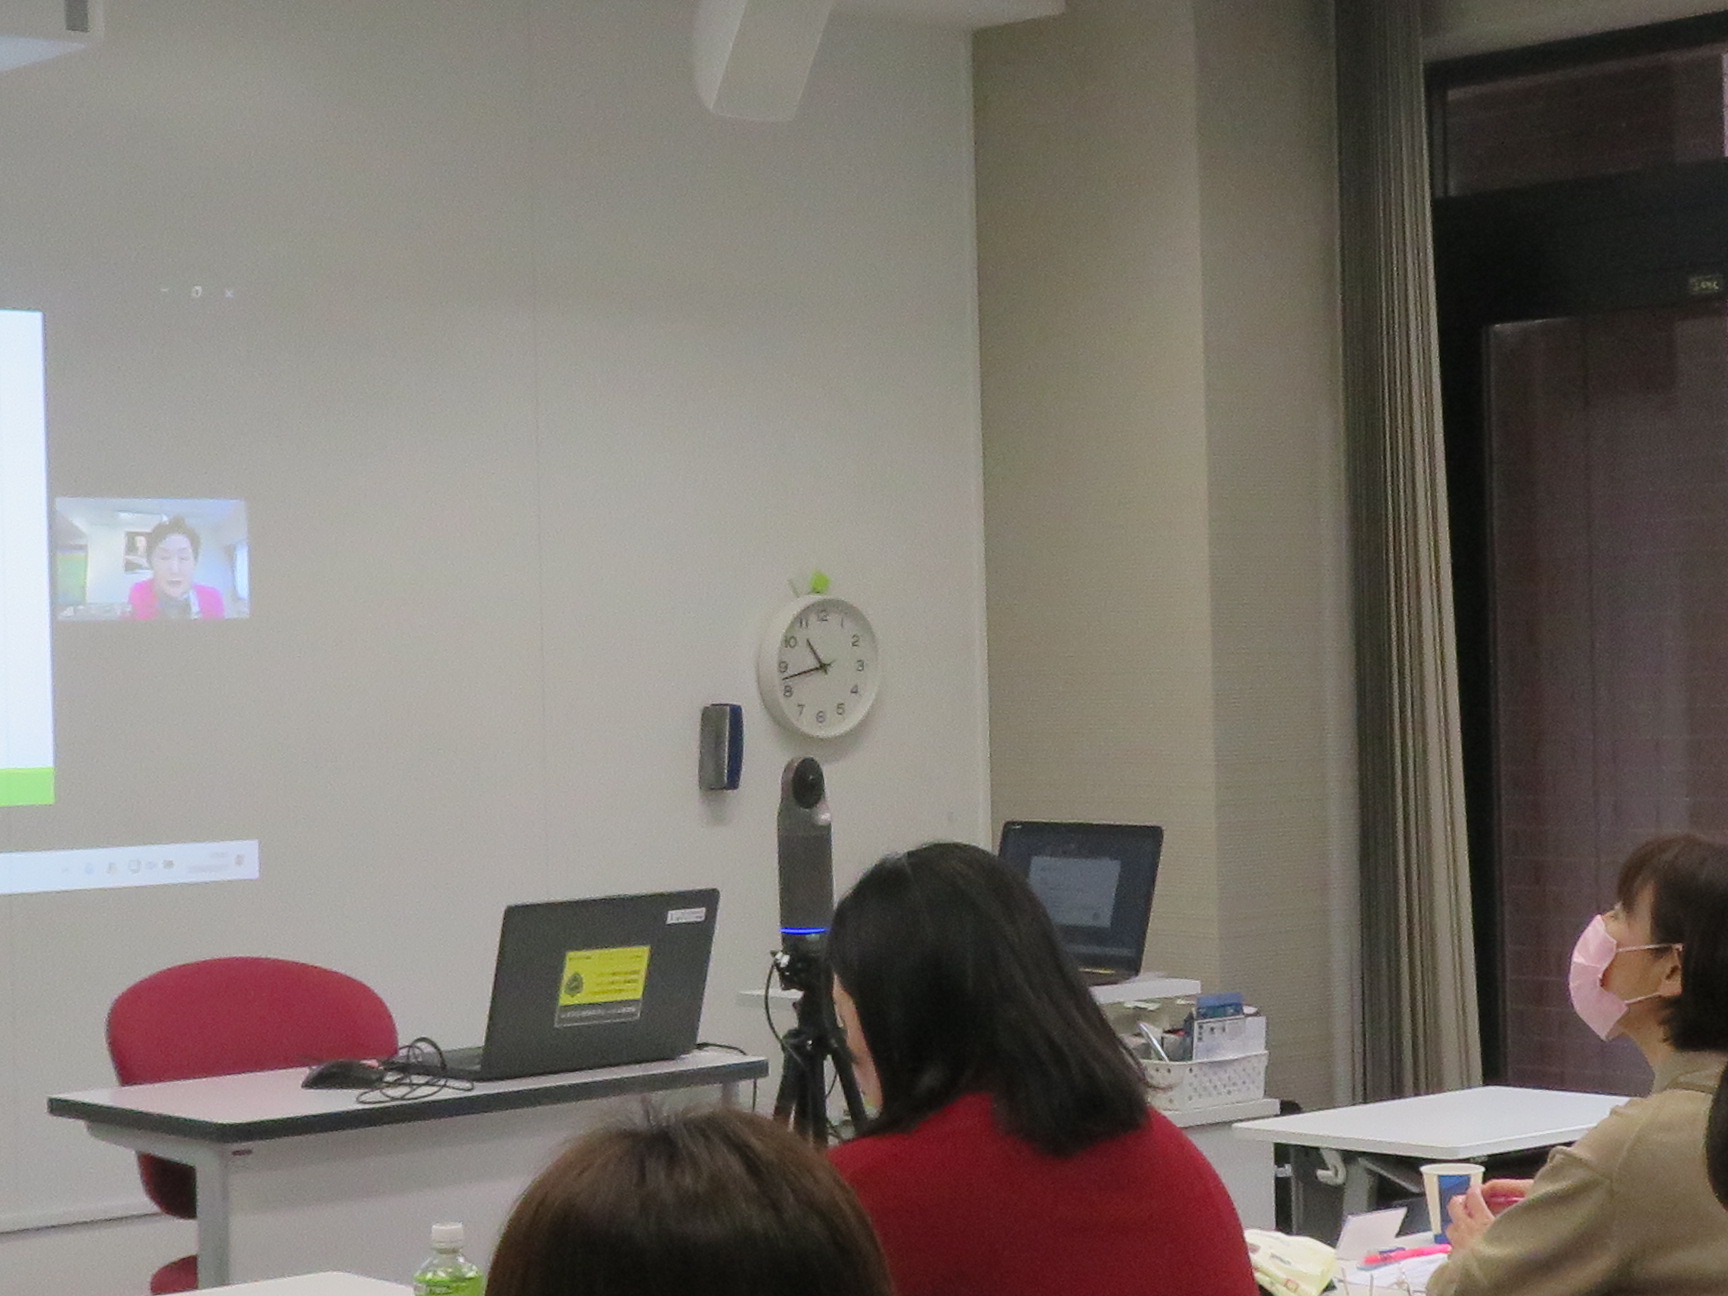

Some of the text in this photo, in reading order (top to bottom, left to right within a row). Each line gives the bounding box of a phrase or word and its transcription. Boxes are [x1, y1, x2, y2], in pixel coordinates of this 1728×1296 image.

[798, 617, 810, 629] 11
[816, 609, 829, 623] 12
[783, 636, 798, 649] 10
[850, 634, 860, 648] 2
[778, 660, 789, 674] 9
[855, 659, 865, 672] 3
[783, 685, 794, 698] 8
[849, 683, 860, 696] 4
[796, 703, 806, 717] 7
[835, 702, 846, 716] 5
[815, 710, 827, 724] 6
